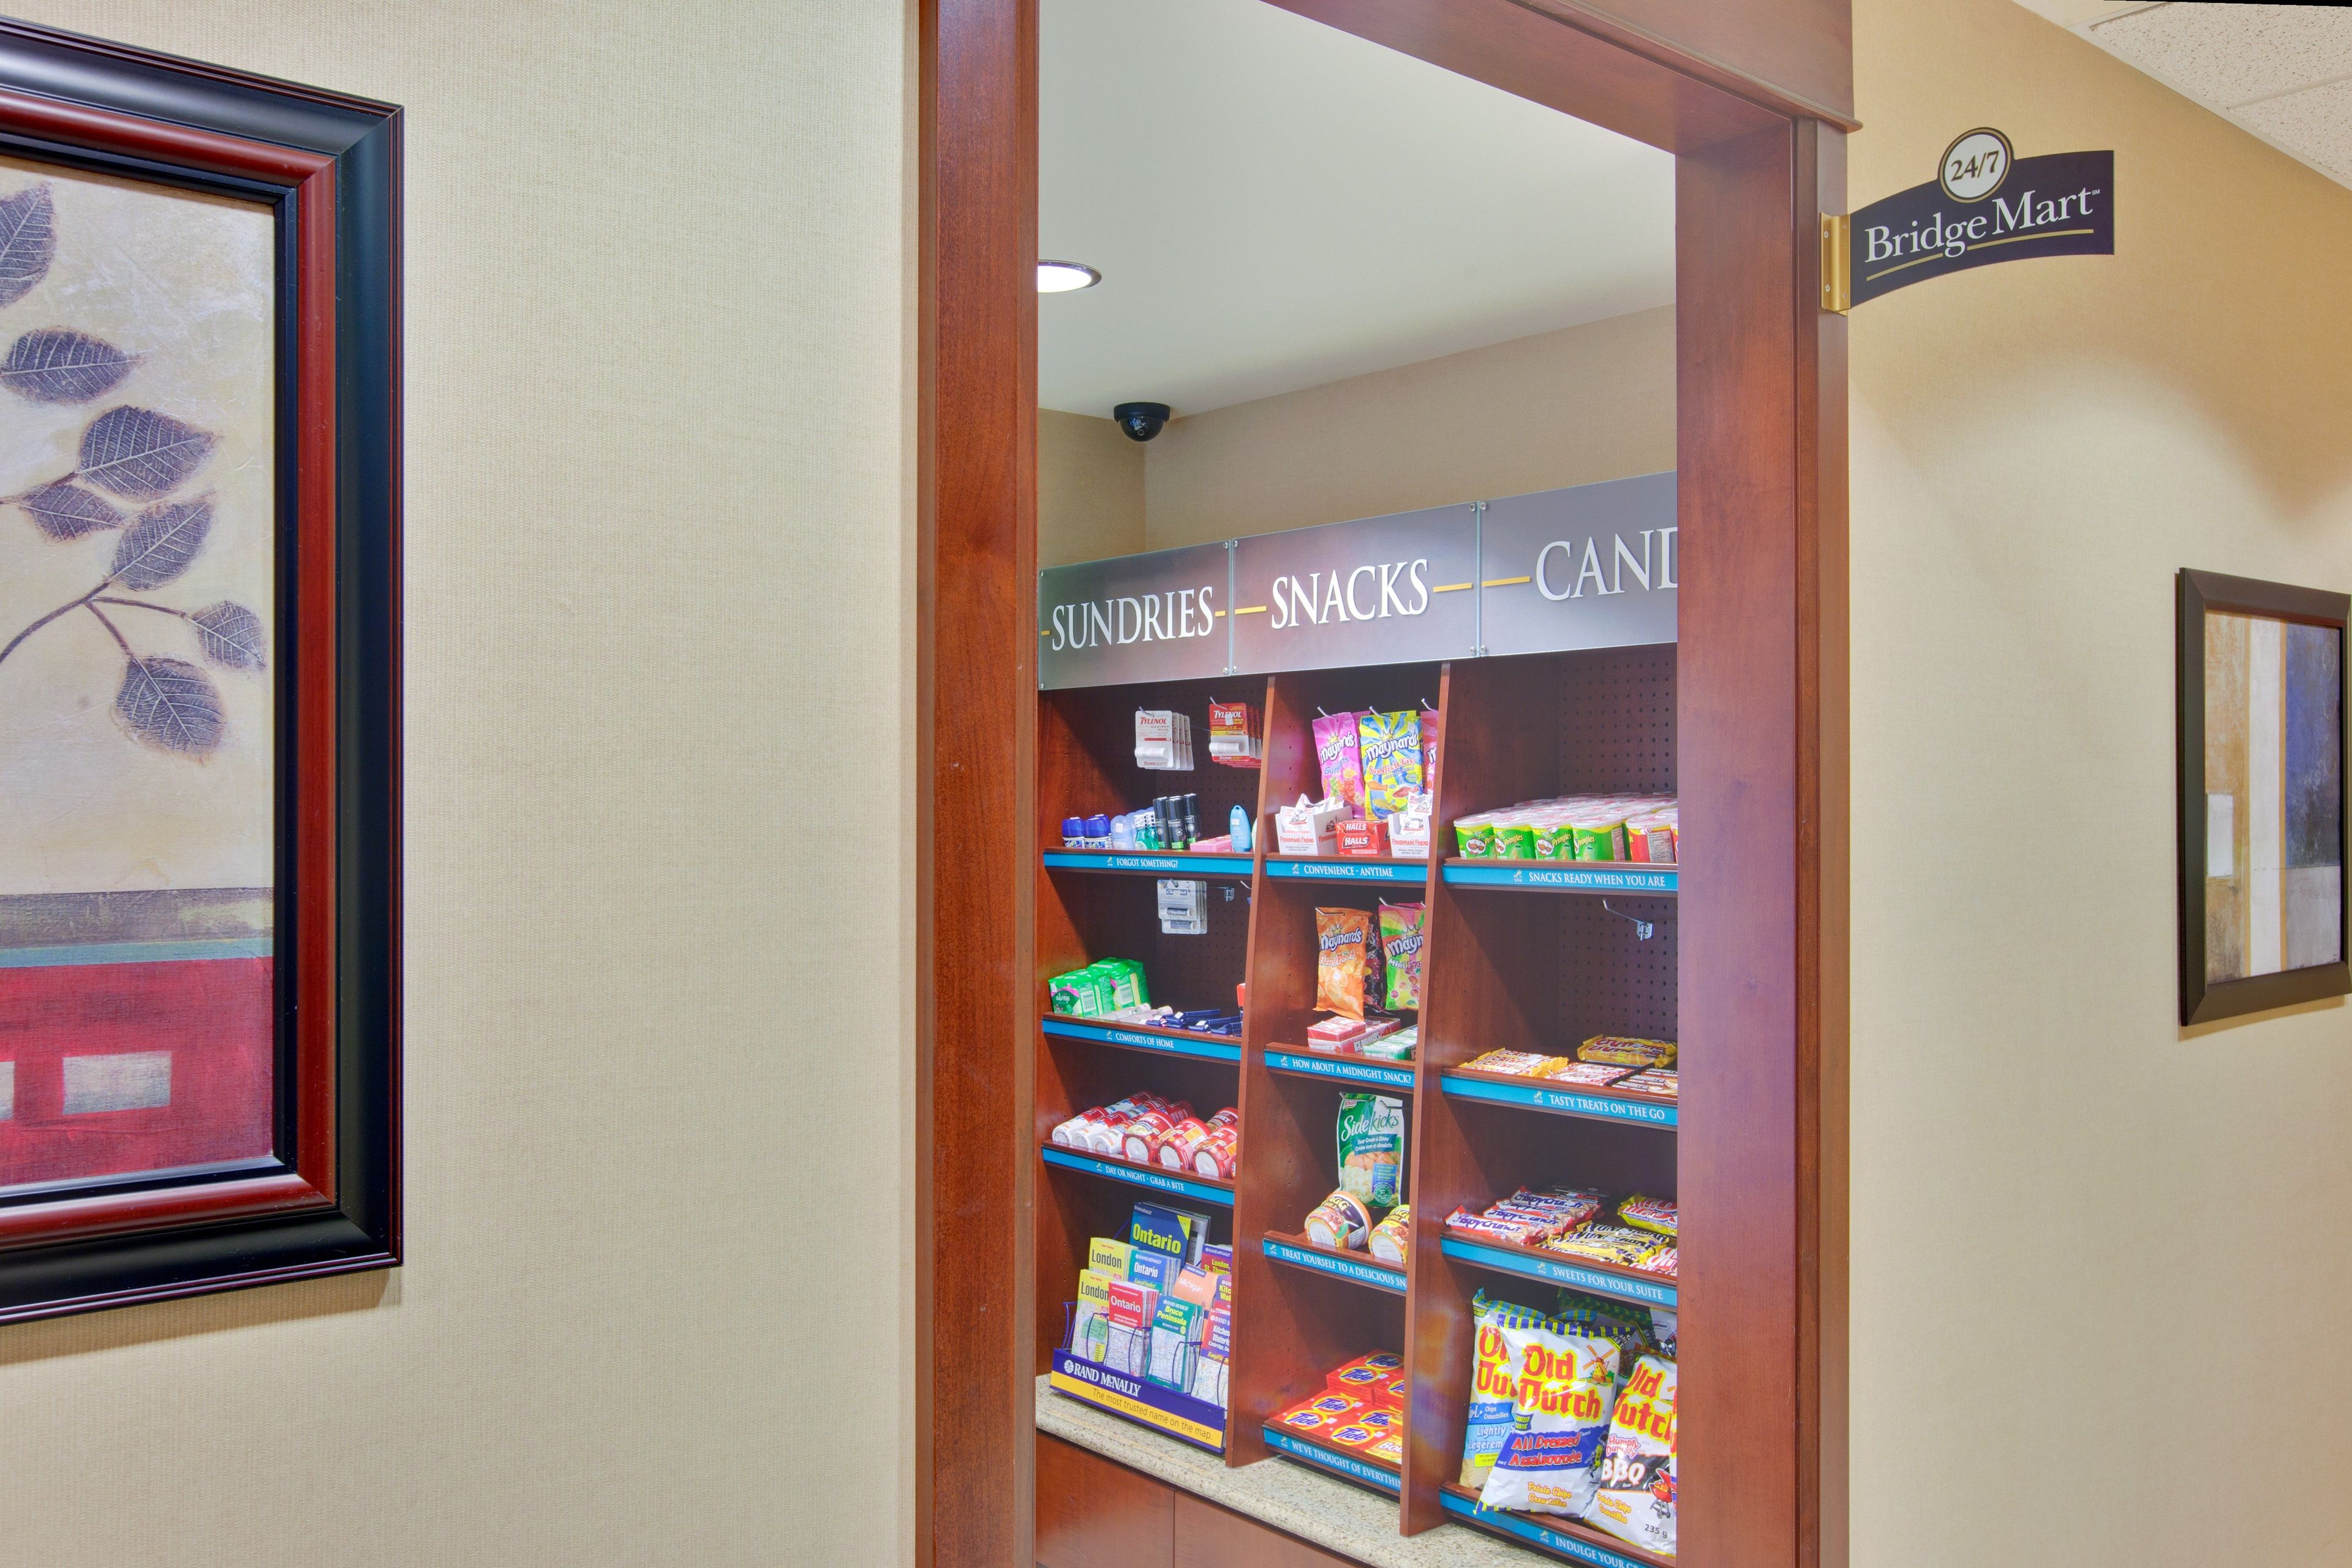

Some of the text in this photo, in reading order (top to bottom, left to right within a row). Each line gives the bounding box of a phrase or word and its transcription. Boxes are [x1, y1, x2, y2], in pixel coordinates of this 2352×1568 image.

[1950, 150, 2000, 183] 24/7
[1864, 211, 1987, 263] Bridge
[1992, 187, 2094, 236] Mart
[1271, 558, 1428, 630] SNACKS
[1052, 586, 1215, 652] SUNDRIES
[1140, 717, 1167, 725] TYLENOL
[1344, 836, 1369, 845] HALLS
[1484, 835, 1494, 846] Prin
[1504, 834, 1523, 845] Pringles
[1551, 832, 1572, 847] Pringles
[1116, 858, 1140, 867] FORGOT
[1141, 859, 1178, 869] SOMETHING?
[1303, 865, 1354, 876] CONVENIENCE
[1360, 867, 1393, 877] ANYTIME
[1529, 872, 1562, 883] SNACKS
[1564, 873, 1593, 884] READY
[1594, 874, 1623, 885] WHEN
[1625, 875, 1646, 886] YOU
[1648, 876, 1665, 886] ARE
[1115, 1033, 1147, 1046] COMFORTS
[1156, 1038, 1174, 1049] HOME
[1292, 1058, 1412, 1084] HOW ABOUT A MIDNIGHT SNACK?
[1548, 1094, 1665, 1120] TASTY TREATS ON THE GO
[1105, 1165, 1116, 1175] DAY
[1117, 1168, 1126, 1177] OR
[1126, 1169, 1145, 1182] NIGHT
[1150, 1177, 1166, 1187] GRAB
[1166, 1179, 1171, 1188] A
[1172, 1180, 1185, 1191] BITE
[1133, 1223, 1182, 1254] Ontario
[1091, 1249, 1122, 1269] London
[1281, 1247, 1406, 1287] TREAT YOURSELF TO A DELICIOUS SN
[1134, 1262, 1158, 1278] Ontario
[1081, 1281, 1109, 1302] London
[1178, 1277, 1204, 1293] Michigan
[1219, 1284, 1232, 1294] Kitc
[1553, 1267, 1663, 1300] SWEETS FOR YOUR SUITE
[1110, 1295, 1141, 1313] Ontario
[1165, 1305, 1183, 1317] Bruce
[1157, 1310, 1187, 1326] Peninsula
[1213, 1324, 1231, 1337] Kitchen
[1213, 1333, 1230, 1346] Waterl
[1478, 1324, 1509, 1363] Ol
[1365, 1355, 1401, 1367] Tide
[1522, 1344, 1575, 1381] Old
[1074, 1362, 1142, 1398] RAND McNALLY
[1340, 1368, 1374, 1382] Tide
[1312, 1398, 1348, 1411] Tide
[1518, 1378, 1602, 1420] Dutch
[1093, 1387, 1213, 1441] The most trusted name on the map.
[1285, 1412, 1320, 1426] Tide
[1360, 1412, 1391, 1425] Tid
[1332, 1427, 1368, 1441] Tide
[1477, 1425, 1507, 1438] Lightly
[1469, 1439, 1503, 1452] Légèrem
[1510, 1431, 1581, 1451] All Dressed
[1608, 1434, 1641, 1449] Humpty
[1291, 1441, 1313, 1456] WE'VE
[1313, 1448, 1351, 1469] THOUGHT
[1351, 1463, 1362, 1474] OF
[1601, 1458, 1646, 1485] BBQ
[1528, 1482, 1572, 1499] Potato Chips
[1615, 1499, 1632, 1513] Chips
[1644, 1523, 1660, 1535] 235
[1555, 1537, 1625, 1568] INDULGE YOUR
